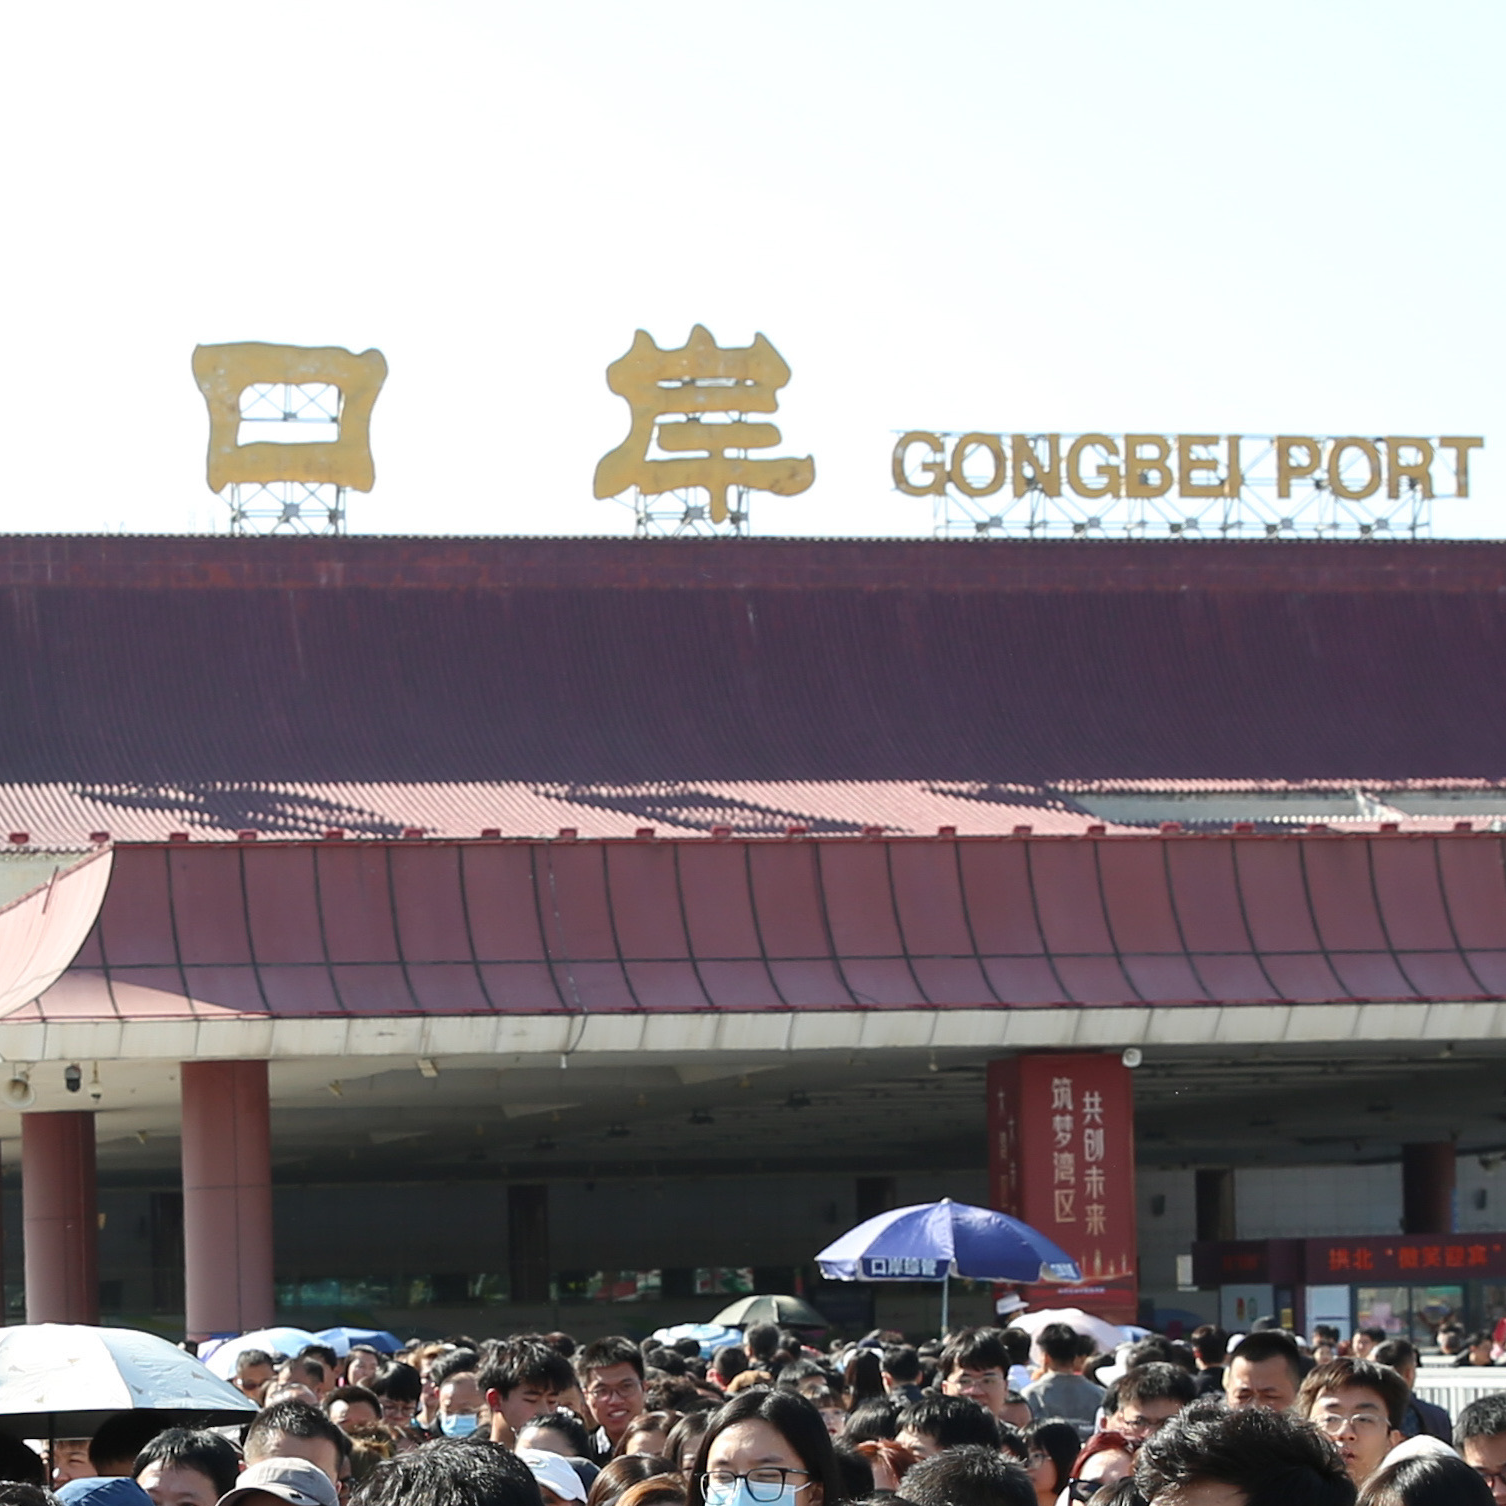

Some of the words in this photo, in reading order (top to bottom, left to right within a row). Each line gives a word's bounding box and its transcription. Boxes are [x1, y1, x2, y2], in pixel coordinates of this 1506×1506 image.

[892, 431, 1242, 497] GONGBEI
[1275, 434, 1485, 500] PORT
[1051, 1077, 1076, 1223] 筑梦湾区
[1082, 1091, 1107, 1236] 共创未来
